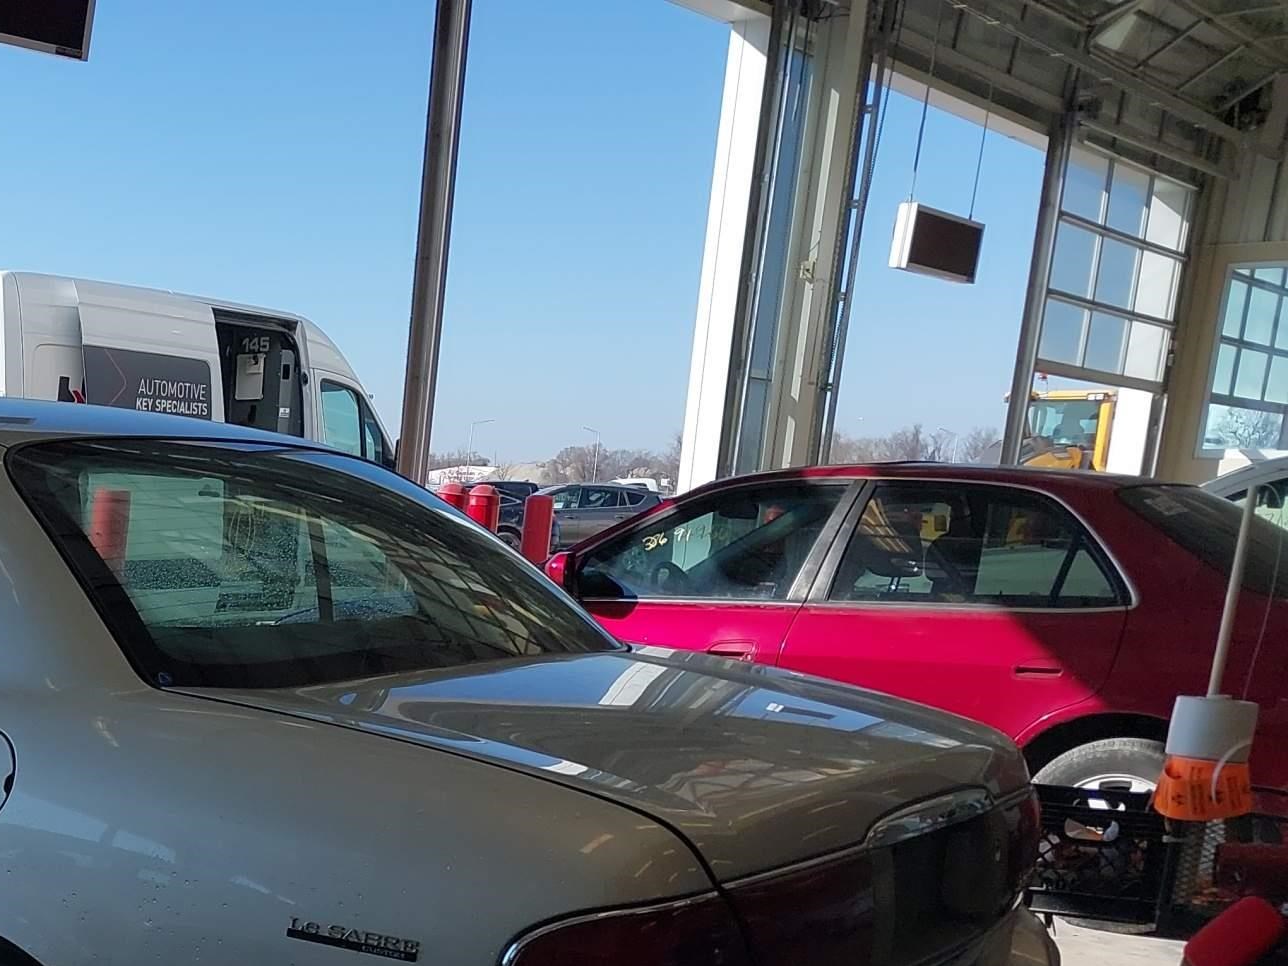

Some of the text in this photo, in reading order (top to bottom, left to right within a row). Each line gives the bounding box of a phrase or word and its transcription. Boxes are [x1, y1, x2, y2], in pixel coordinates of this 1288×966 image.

[242, 336, 270, 353] 145
[138, 378, 207, 401] AUTOMOTIVE
[136, 397, 208, 416] KEY SPECIALISTS
